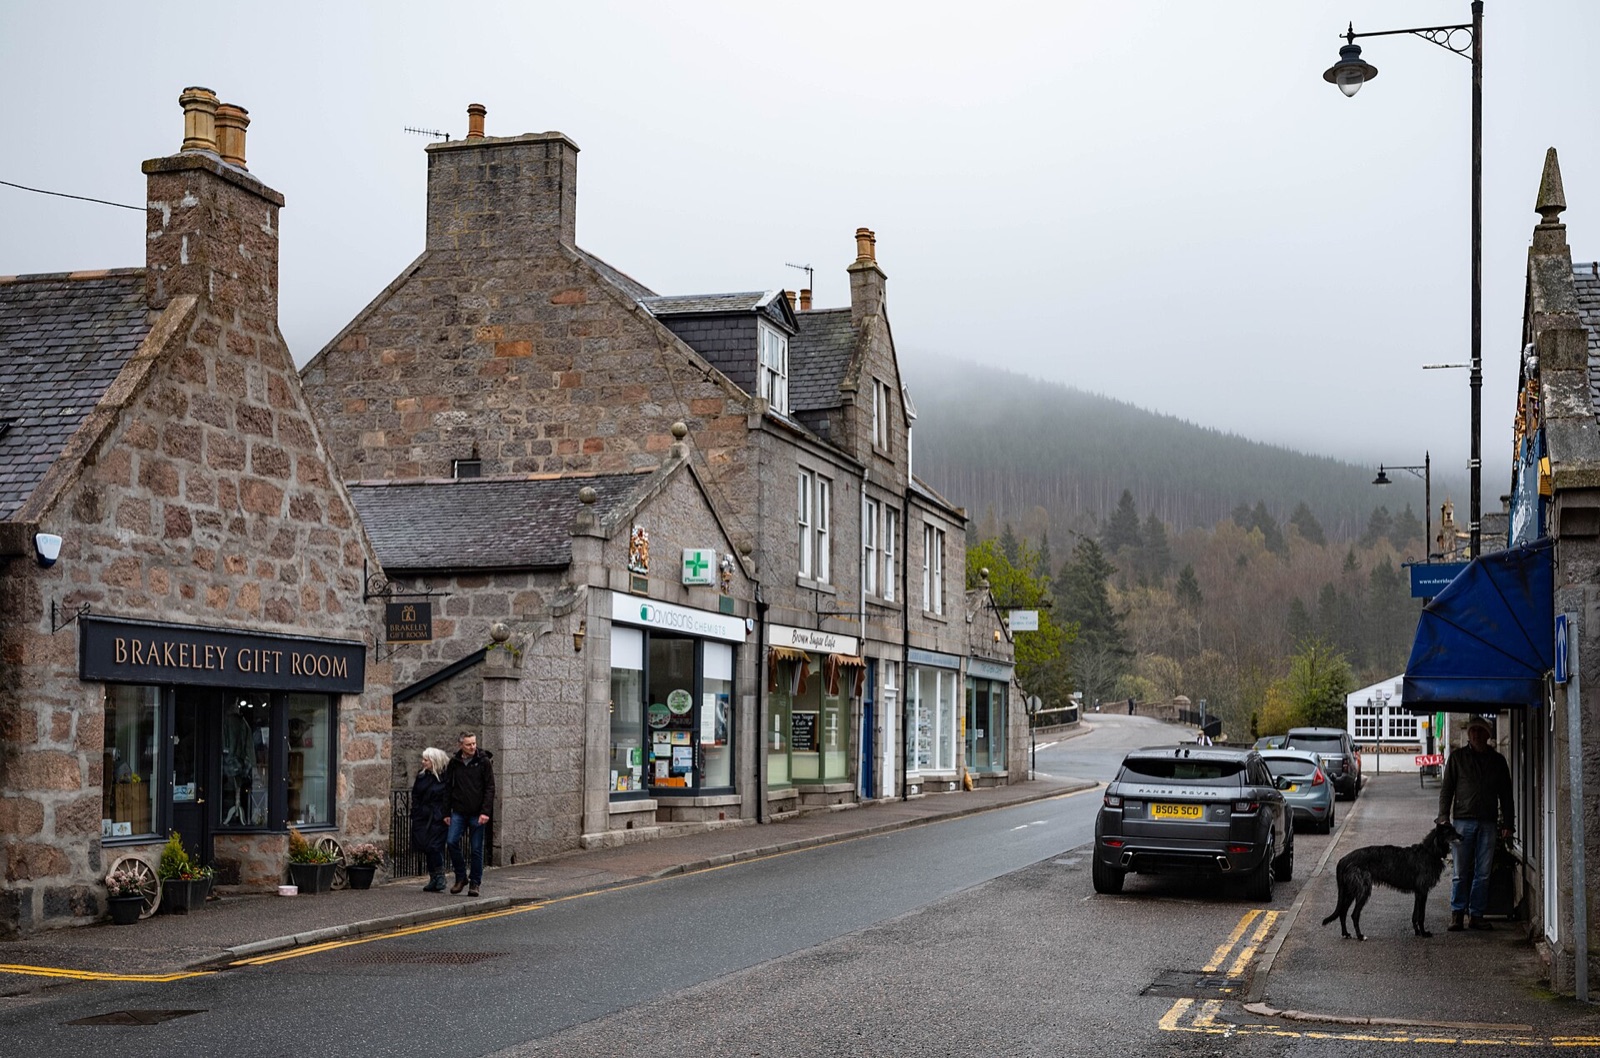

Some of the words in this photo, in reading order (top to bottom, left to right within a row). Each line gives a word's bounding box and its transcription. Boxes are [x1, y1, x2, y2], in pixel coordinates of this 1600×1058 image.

[390, 624, 428, 632] BRAKELEY
[646, 604, 693, 630] Davidsons
[694, 620, 727, 636] CHEMISTS
[791, 629, 809, 644] Brown
[809, 632, 823, 649] Sugar
[115, 637, 228, 670] BRAKELEY
[237, 648, 283, 674] GIFT
[291, 652, 349, 679] ROOM
[1415, 756, 1443, 765] SALE
